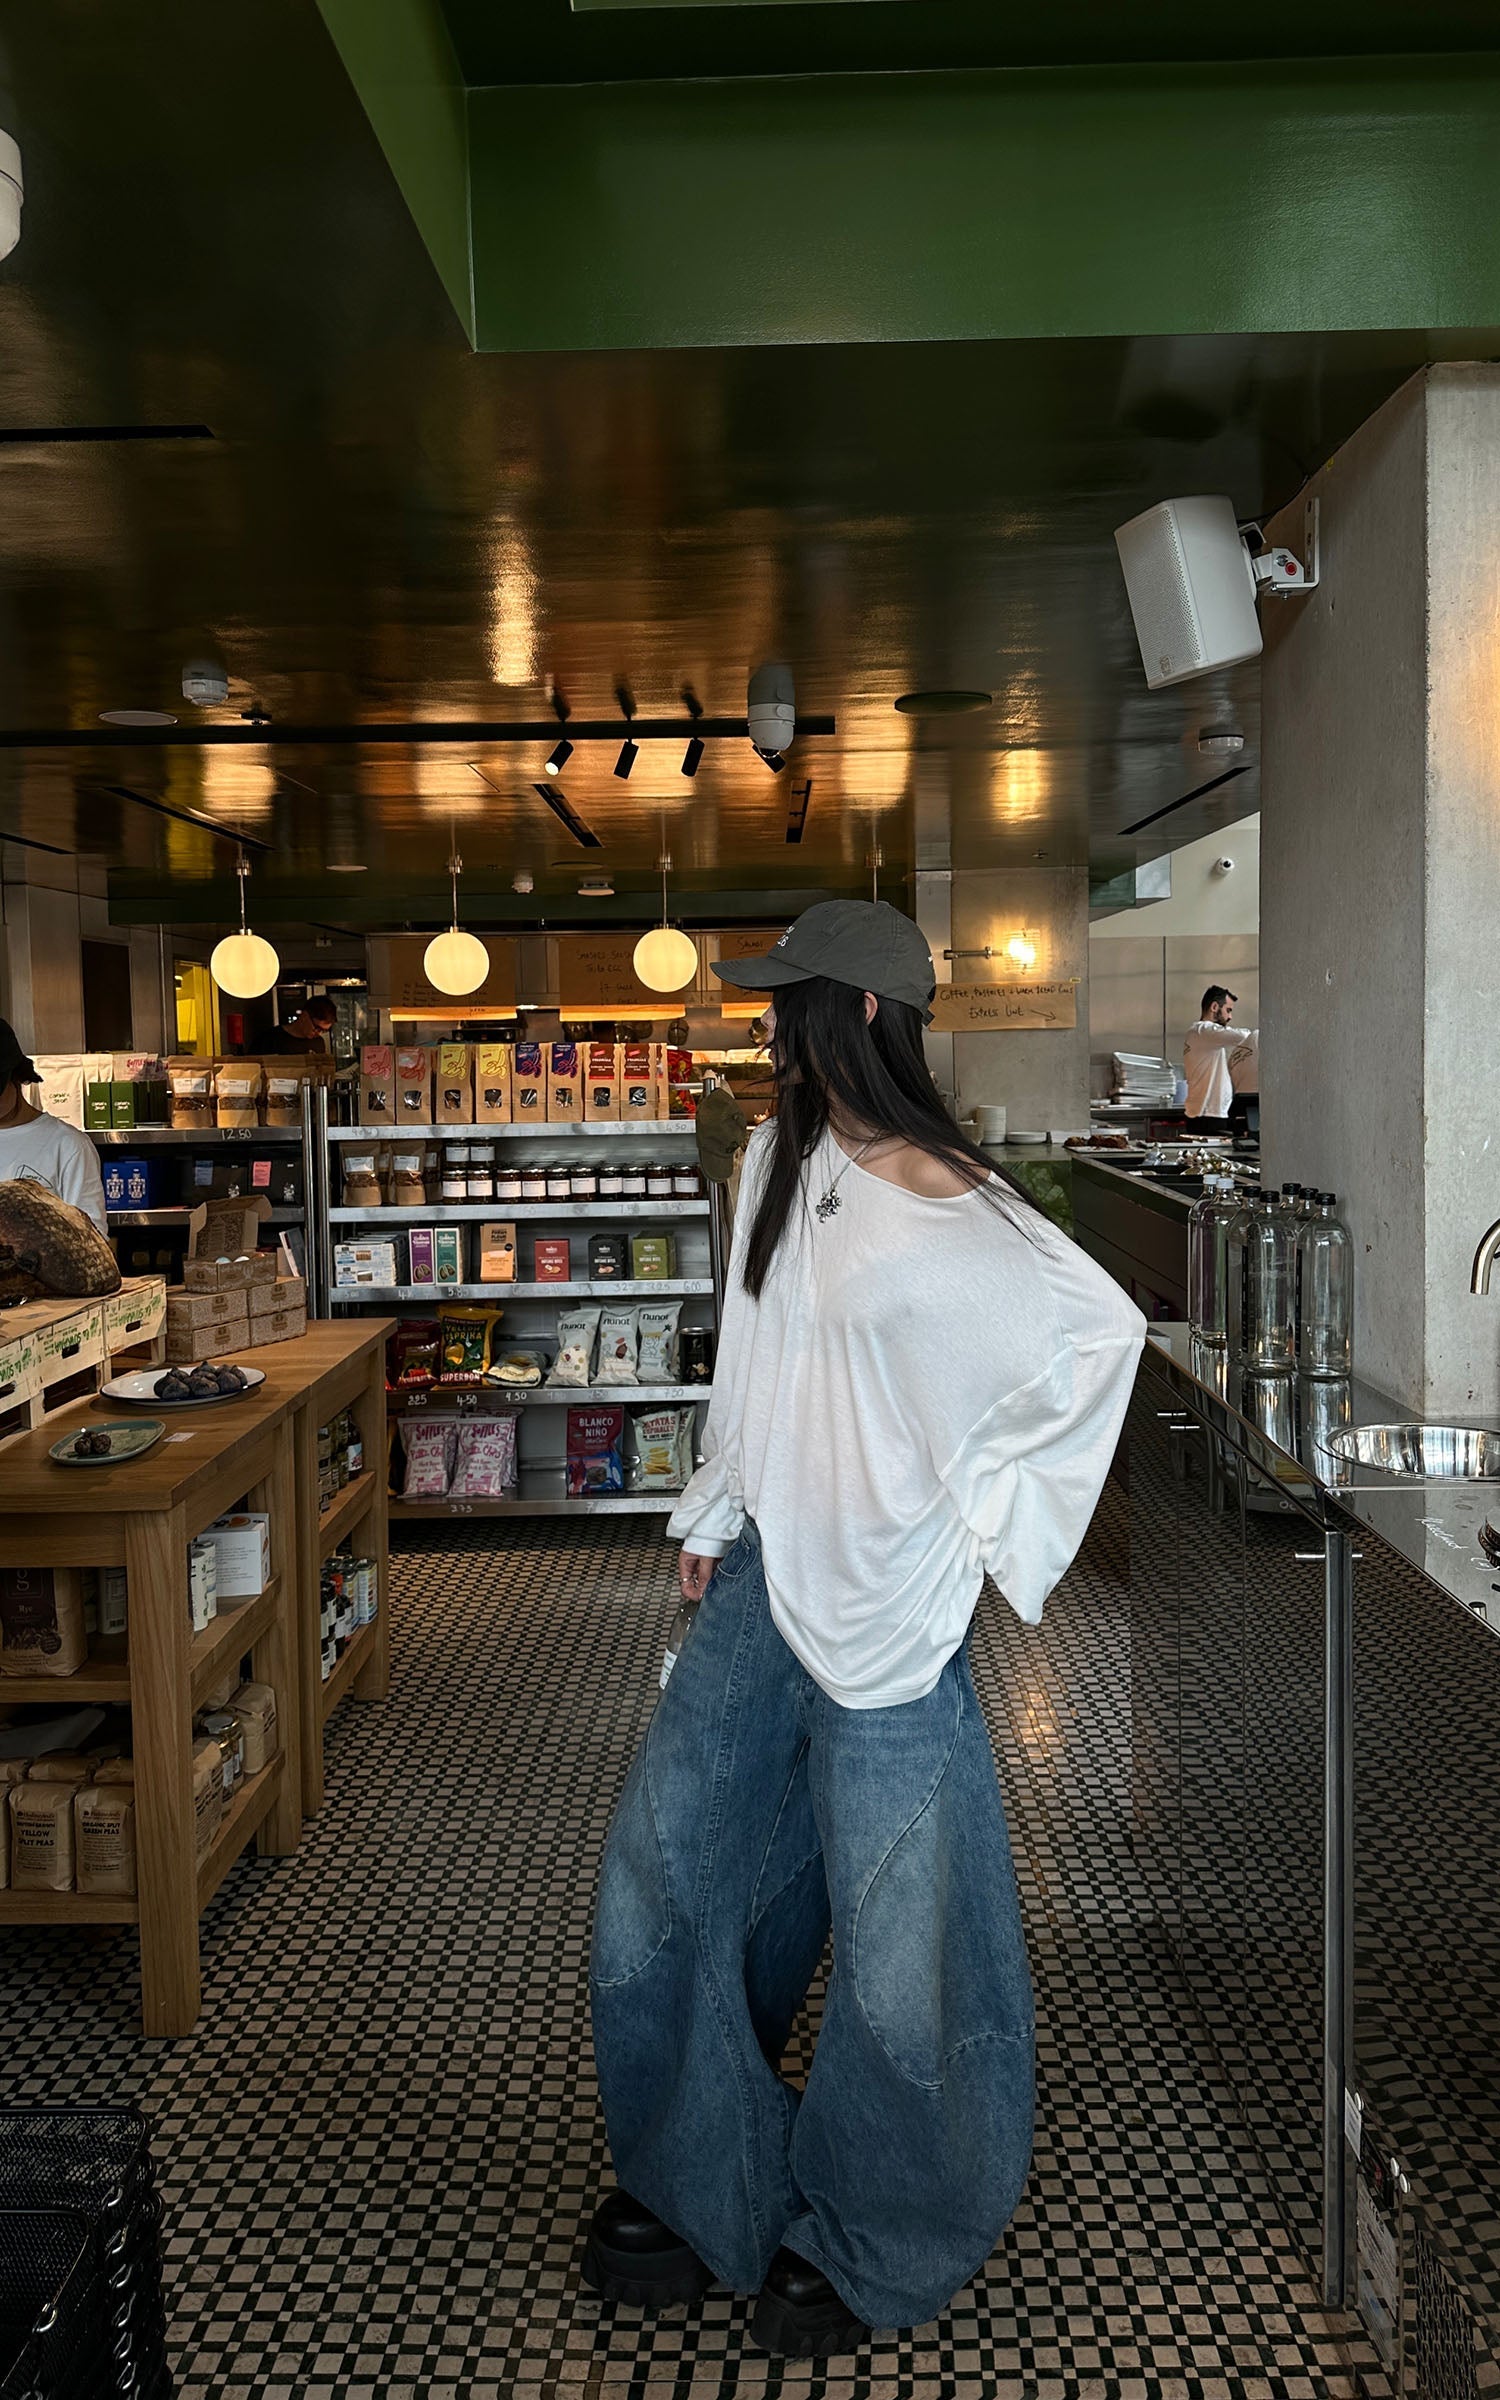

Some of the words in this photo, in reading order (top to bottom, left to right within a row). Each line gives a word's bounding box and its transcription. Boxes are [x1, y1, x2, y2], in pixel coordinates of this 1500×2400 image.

[578, 1416, 614, 1427] BLANCO
[20, 1829, 50, 1837] YELLOW
[35, 1839, 55, 1847] PEAS
